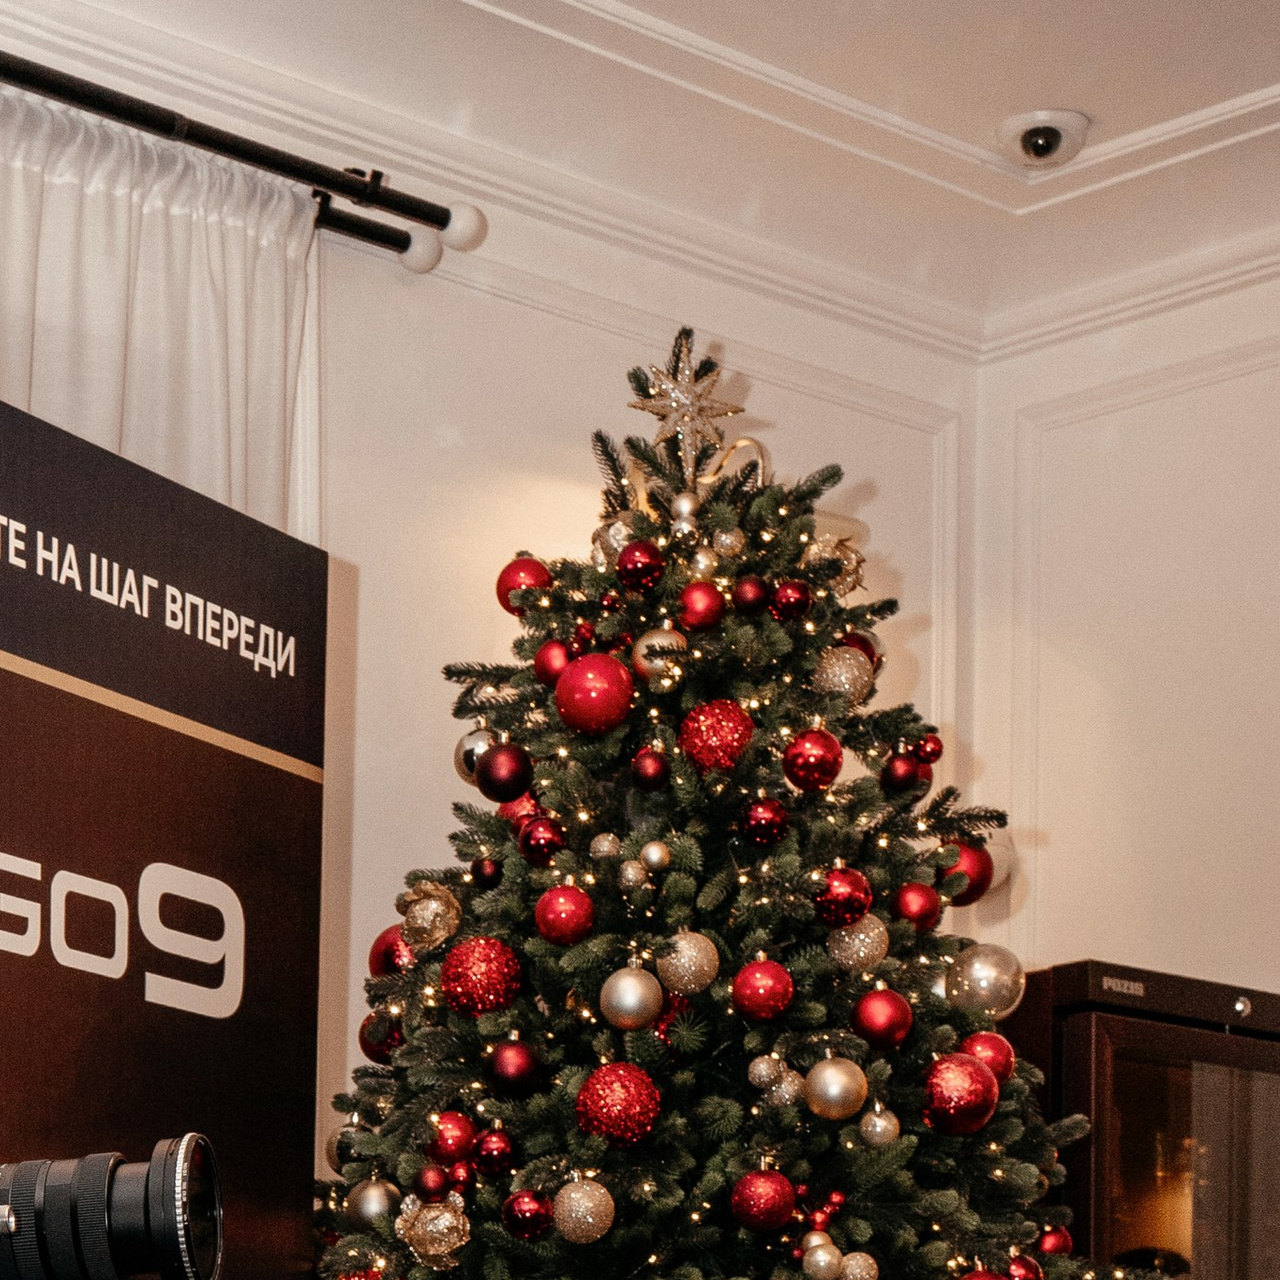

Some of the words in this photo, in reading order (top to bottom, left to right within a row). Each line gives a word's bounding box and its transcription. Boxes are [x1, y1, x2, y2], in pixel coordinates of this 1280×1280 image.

[36, 530, 83, 591] НА
[89, 552, 159, 618] ШАГ
[165, 584, 296, 678] ВПЕРЕДИ
